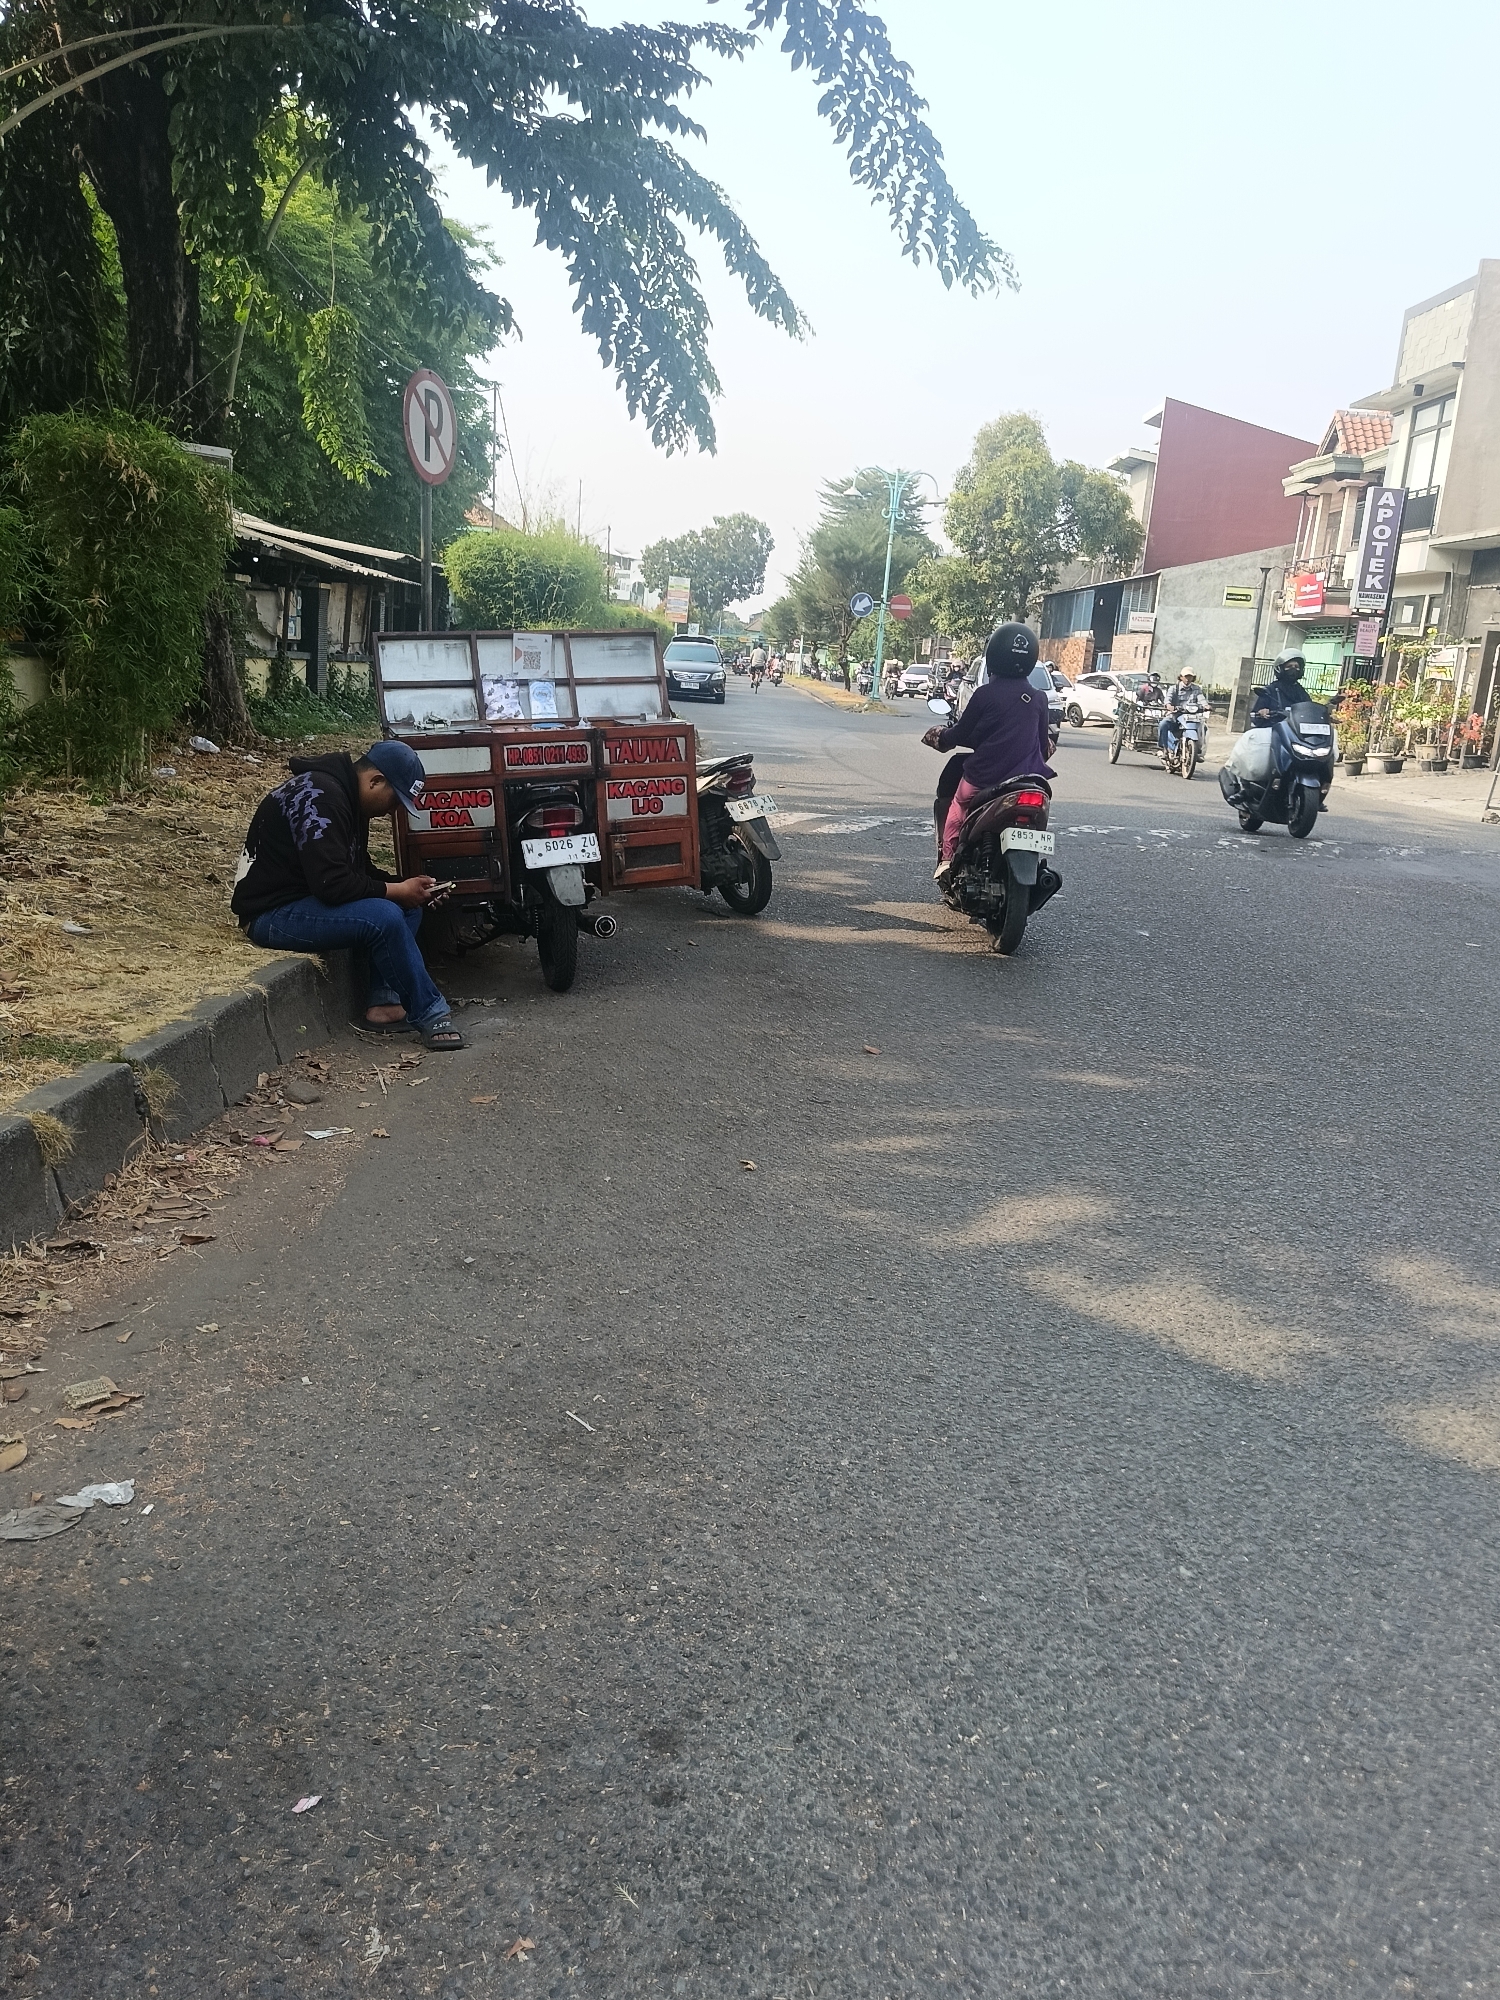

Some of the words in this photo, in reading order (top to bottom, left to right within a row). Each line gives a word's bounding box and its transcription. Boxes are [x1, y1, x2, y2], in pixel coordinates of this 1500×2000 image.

[424, 388, 444, 463] P
[1365, 491, 1396, 590] APOTEK
[1358, 592, 1386, 600] NAWASENA
[522, 745, 544, 765] 0851
[544, 745, 566, 764] 0211
[565, 744, 589, 763] 4933
[604, 738, 682, 765] TAUWA
[607, 779, 685, 799] KACANG
[631, 797, 664, 816] IJO
[430, 809, 475, 828] KOA
[525, 843, 535, 855] W
[544, 838, 574, 852] 6026
[580, 836, 597, 848] ZU
